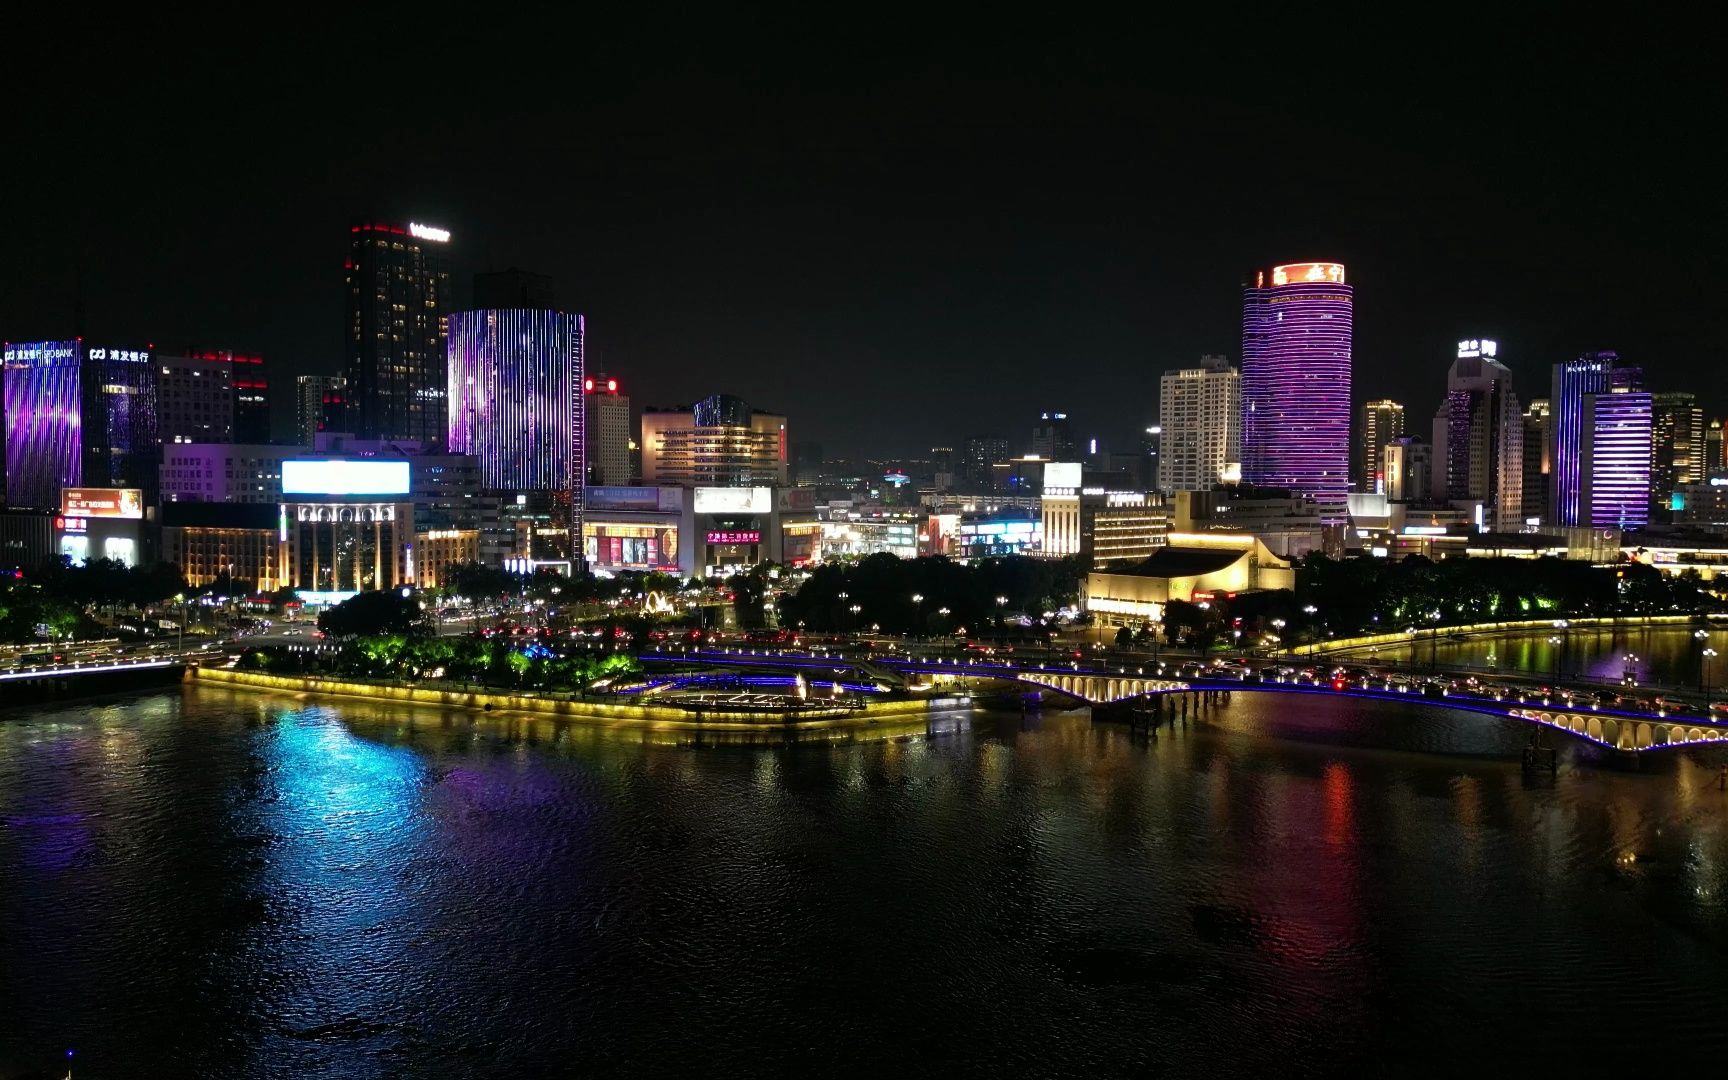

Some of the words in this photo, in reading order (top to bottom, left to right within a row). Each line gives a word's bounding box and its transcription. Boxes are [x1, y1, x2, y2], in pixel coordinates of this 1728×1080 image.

[16, 349, 42, 360] 浦发银行
[56, 348, 73, 358] BANK
[110, 349, 149, 363] 浦发银行
